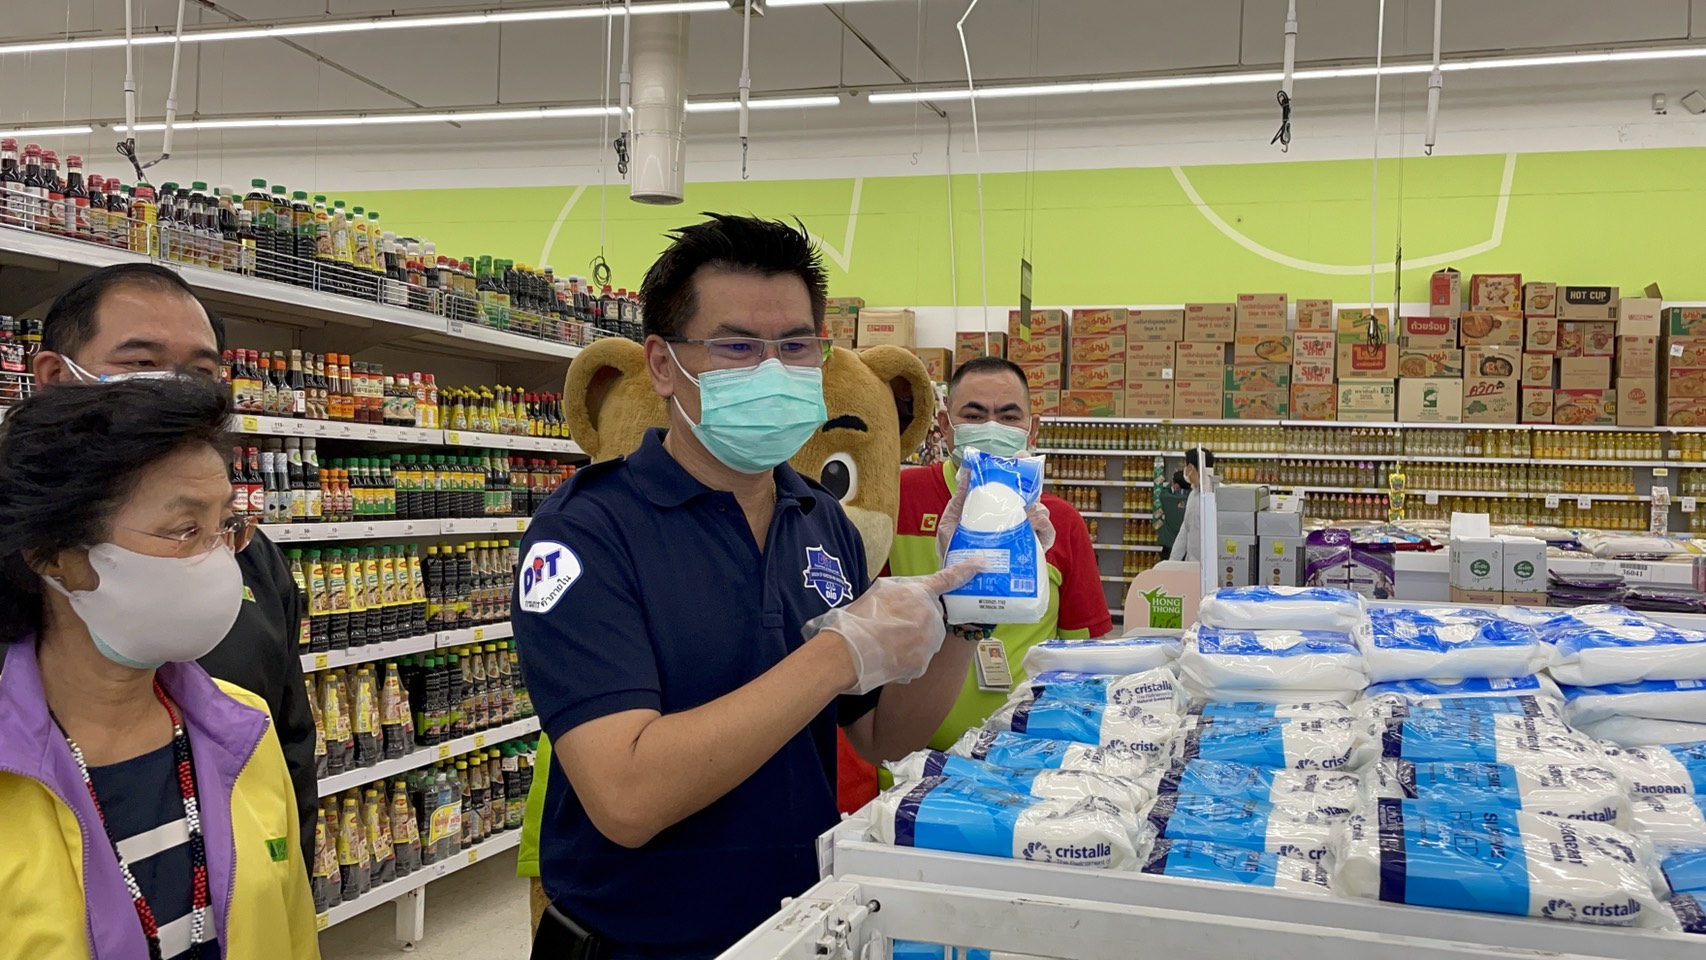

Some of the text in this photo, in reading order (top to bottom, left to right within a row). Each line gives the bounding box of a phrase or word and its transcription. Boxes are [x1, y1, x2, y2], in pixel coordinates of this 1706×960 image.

[1570, 291, 1607, 300] HOT CUP
[1030, 313, 1046, 325] าม่า
[1303, 341, 1332, 350] SUPER
[1301, 367, 1331, 376] SUPER
[1621, 569, 1643, 577] 36041
[1152, 597, 1181, 607] HONG
[1152, 606, 1181, 614] THONG
[1134, 680, 1173, 695] cristalla
[1055, 842, 1111, 859] cristalla
[1582, 898, 1641, 917] cristalla
